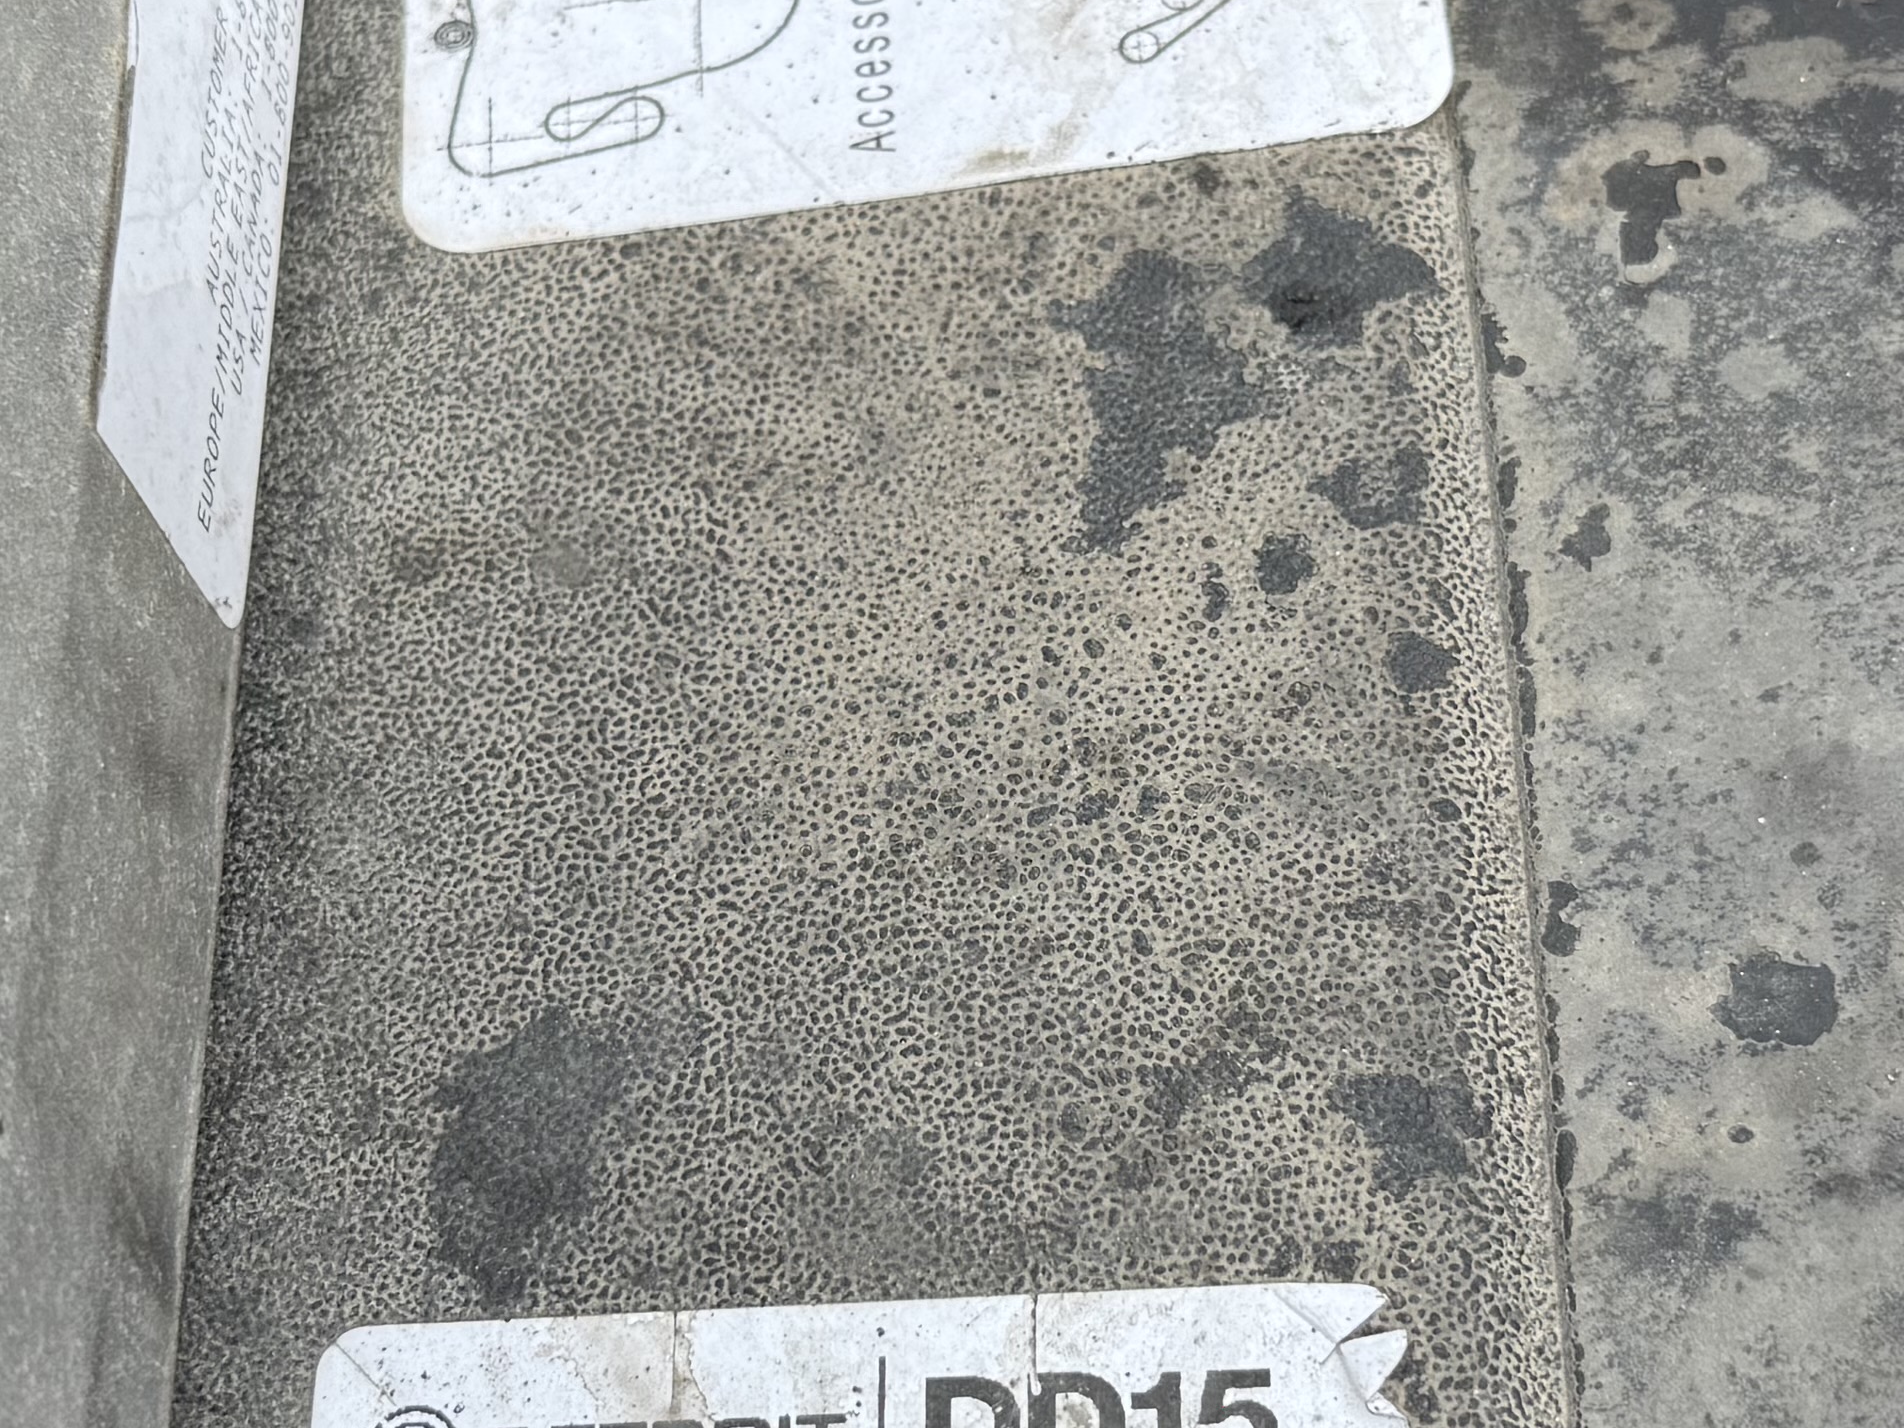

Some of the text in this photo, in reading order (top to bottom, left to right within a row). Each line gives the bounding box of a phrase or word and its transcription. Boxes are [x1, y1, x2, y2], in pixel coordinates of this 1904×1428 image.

[204, 81, 238, 309] AUSTRALIA:
[229, 321, 248, 400] USA
[240, 126, 266, 283] CANADA:
[248, 210, 275, 370] MEXICO:
[196, 227, 240, 539] EUROPE/MIDDLE
